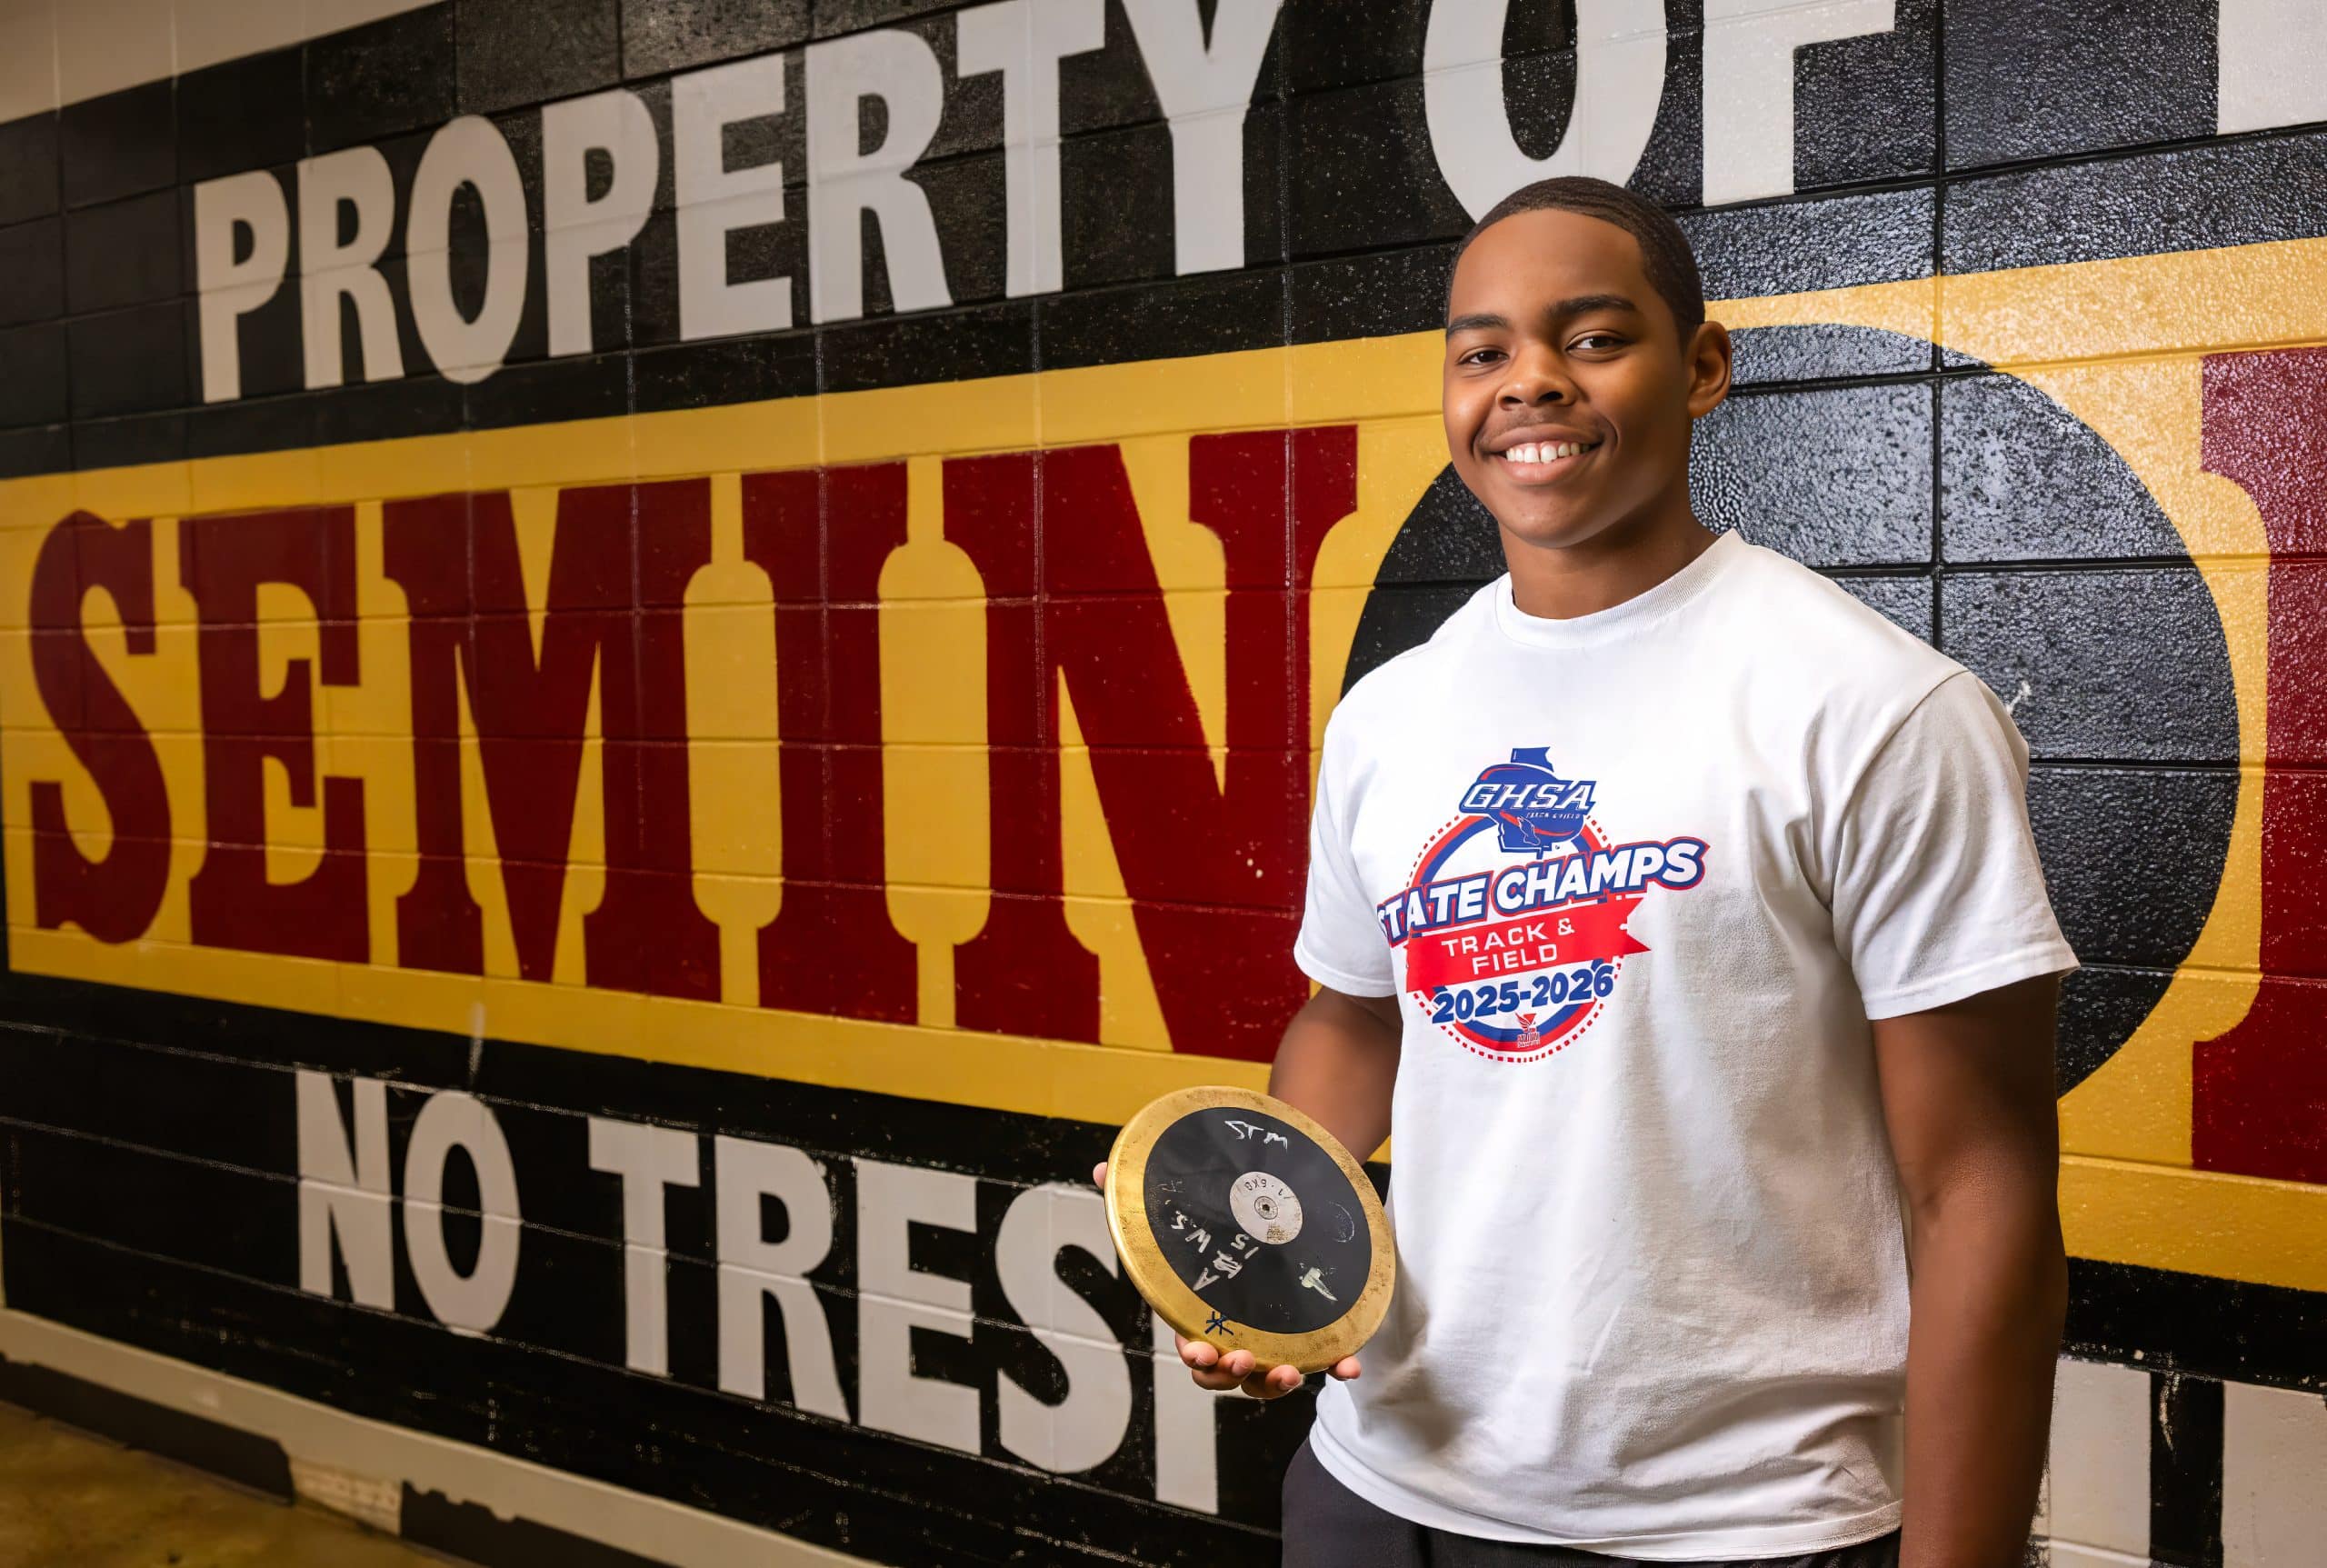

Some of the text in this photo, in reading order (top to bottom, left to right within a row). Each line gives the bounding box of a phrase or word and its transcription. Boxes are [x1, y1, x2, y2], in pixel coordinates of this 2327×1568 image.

[194, 0, 1278, 404] PROPERTY
[1462, 779, 1595, 812] GHSA
[1494, 840, 1706, 913] CHAMPS
[1441, 917, 1575, 957] TRACK &
[1473, 943, 1558, 975] FIELD
[1432, 964, 1615, 1024] 2025-2026
[295, 1069, 521, 1338] NO
